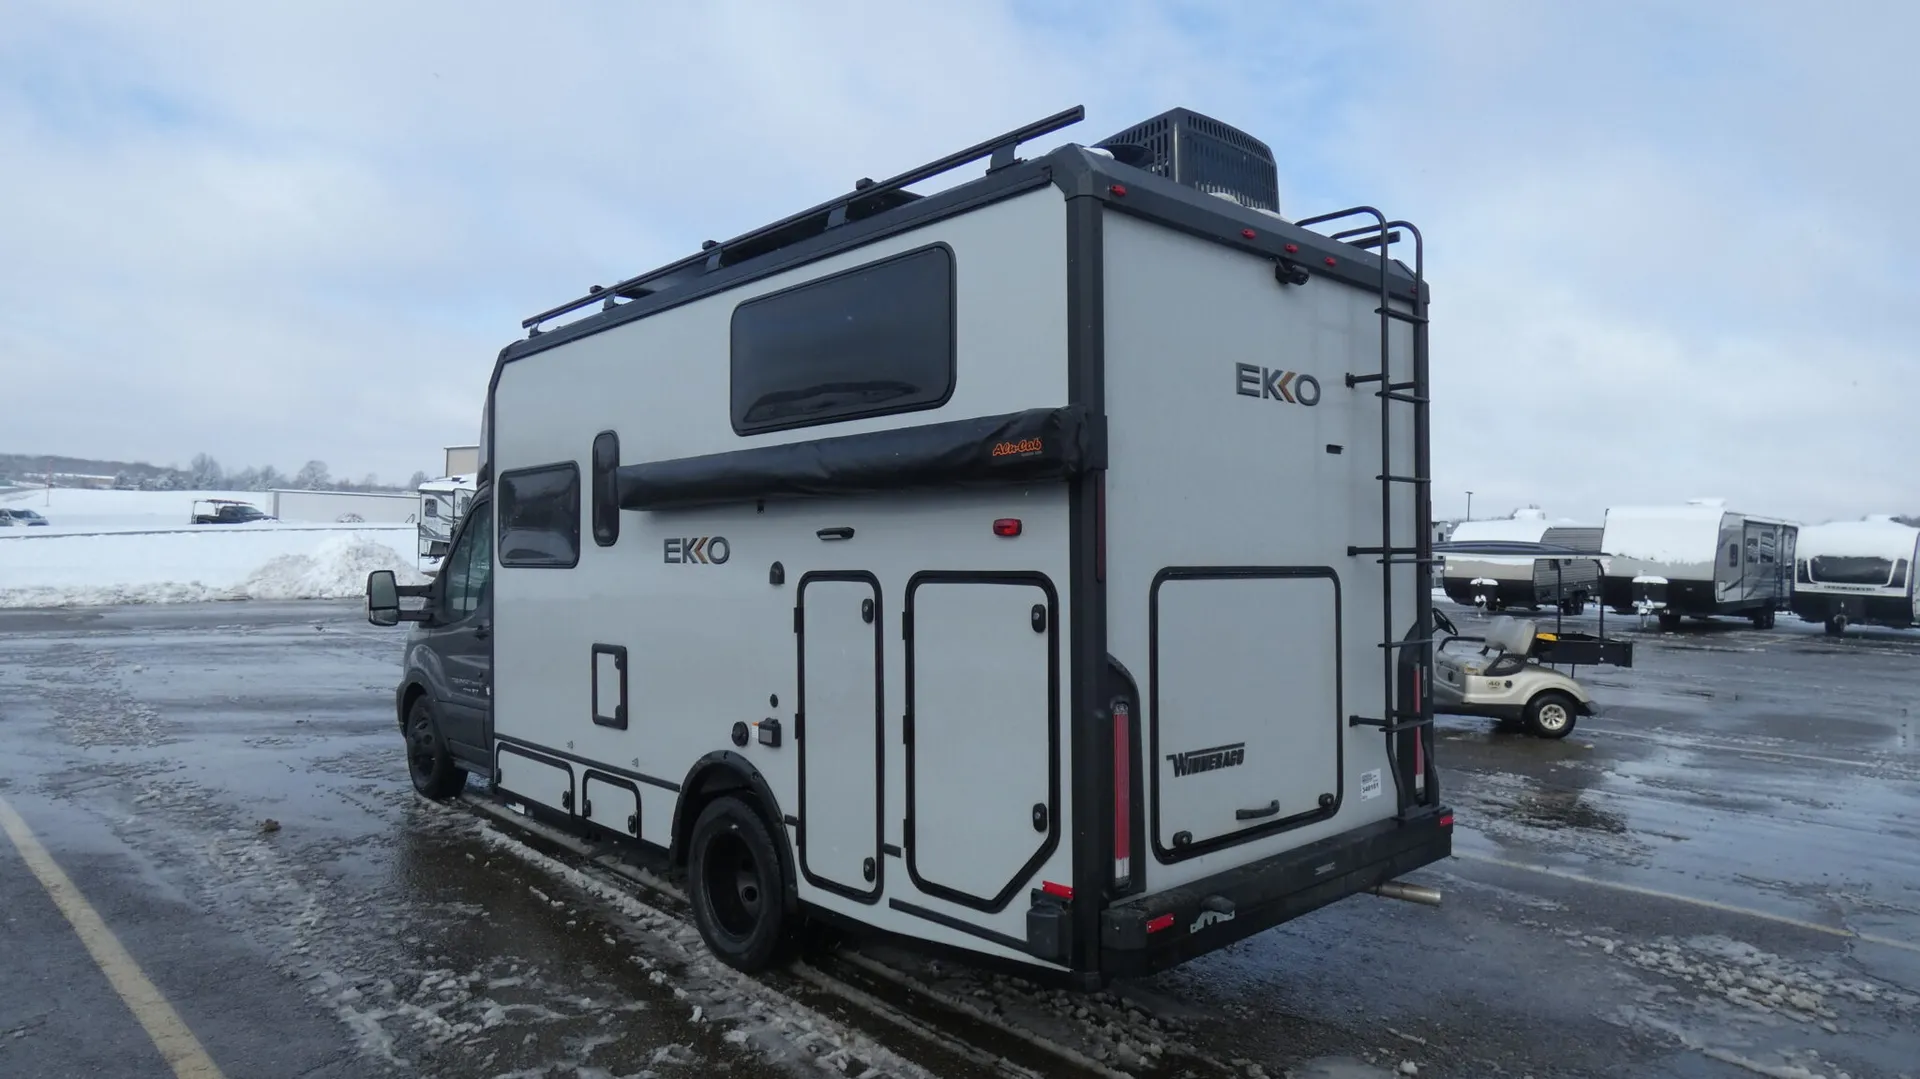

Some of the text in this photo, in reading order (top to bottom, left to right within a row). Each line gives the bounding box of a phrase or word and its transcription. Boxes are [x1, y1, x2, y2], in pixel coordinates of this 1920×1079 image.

[1235, 362, 1321, 407] EKKO
[992, 438, 1043, 456] Alu-Cab
[663, 536, 731, 565] EKKO
